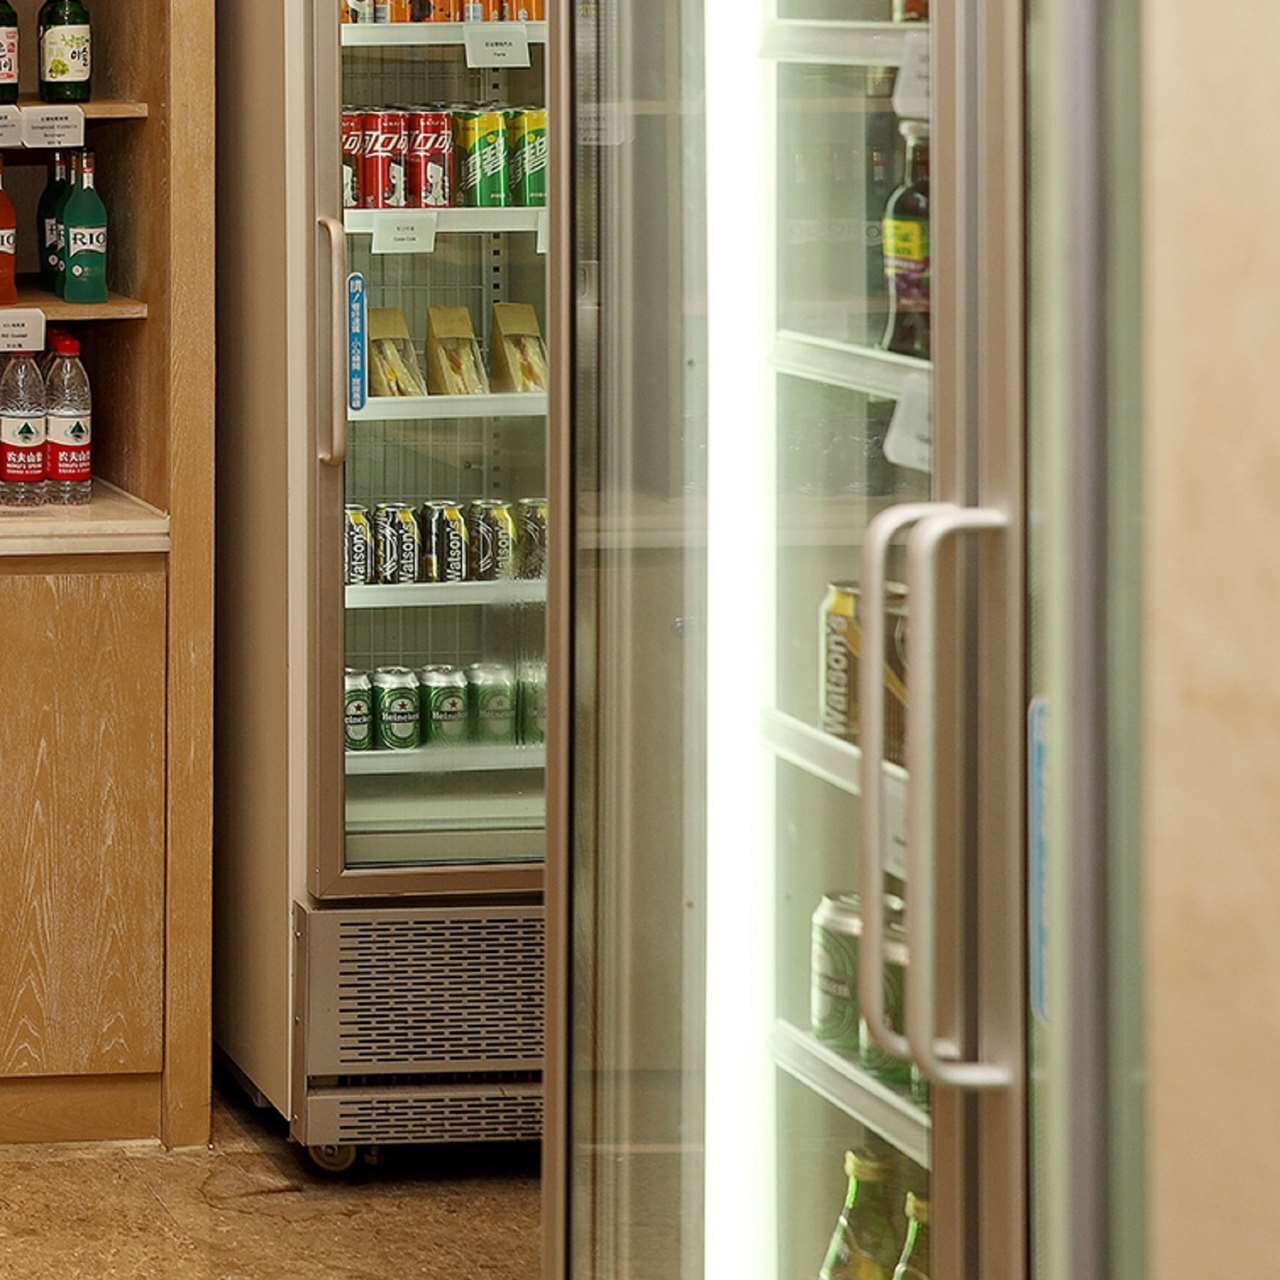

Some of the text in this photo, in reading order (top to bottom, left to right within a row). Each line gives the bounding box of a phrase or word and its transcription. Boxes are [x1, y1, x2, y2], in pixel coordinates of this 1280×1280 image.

[73, 232, 105, 246] RIO
[58, 450, 90, 463] 农夫山
